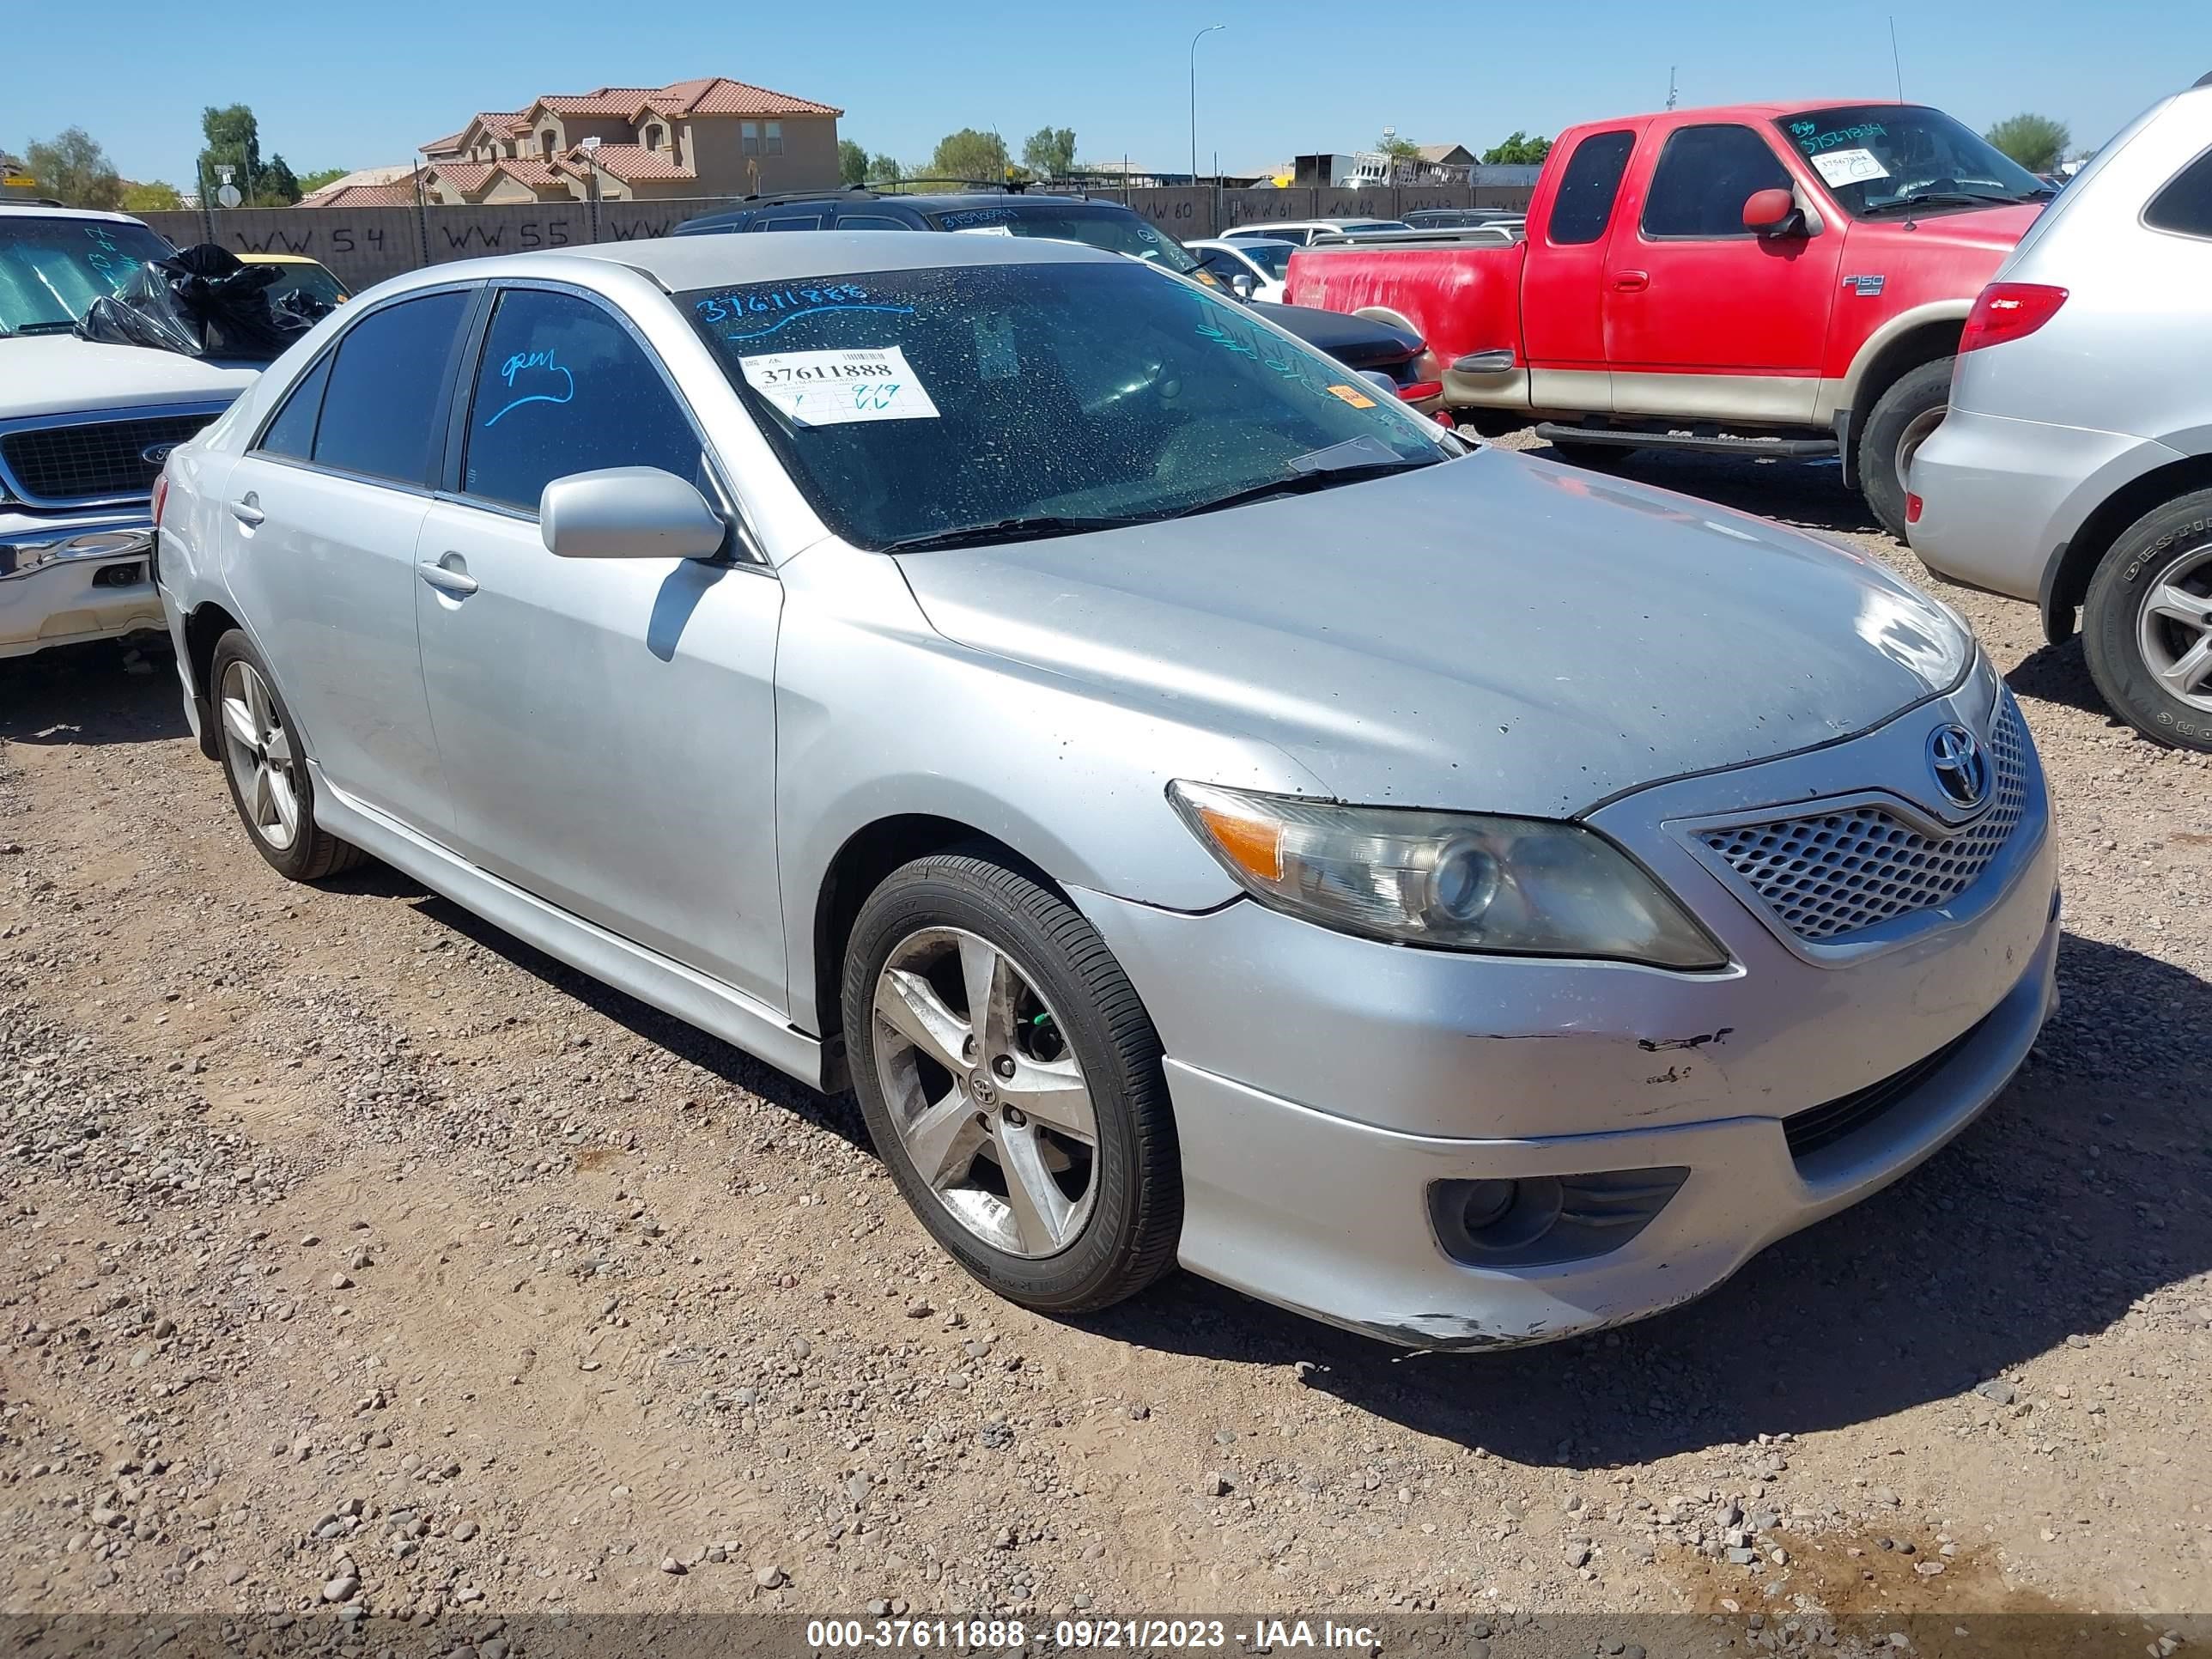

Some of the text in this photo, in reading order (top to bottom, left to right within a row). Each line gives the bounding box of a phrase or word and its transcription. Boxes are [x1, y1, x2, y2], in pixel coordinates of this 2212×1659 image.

[1175, 202, 1193, 219] 60
[1279, 202, 1292, 217] 61
[1358, 200, 1375, 216] 62
[236, 228, 384, 254] WW 54
[441, 224, 502, 249] WW
[696, 283, 868, 324] 37611888
[761, 363, 893, 385] 37611888
